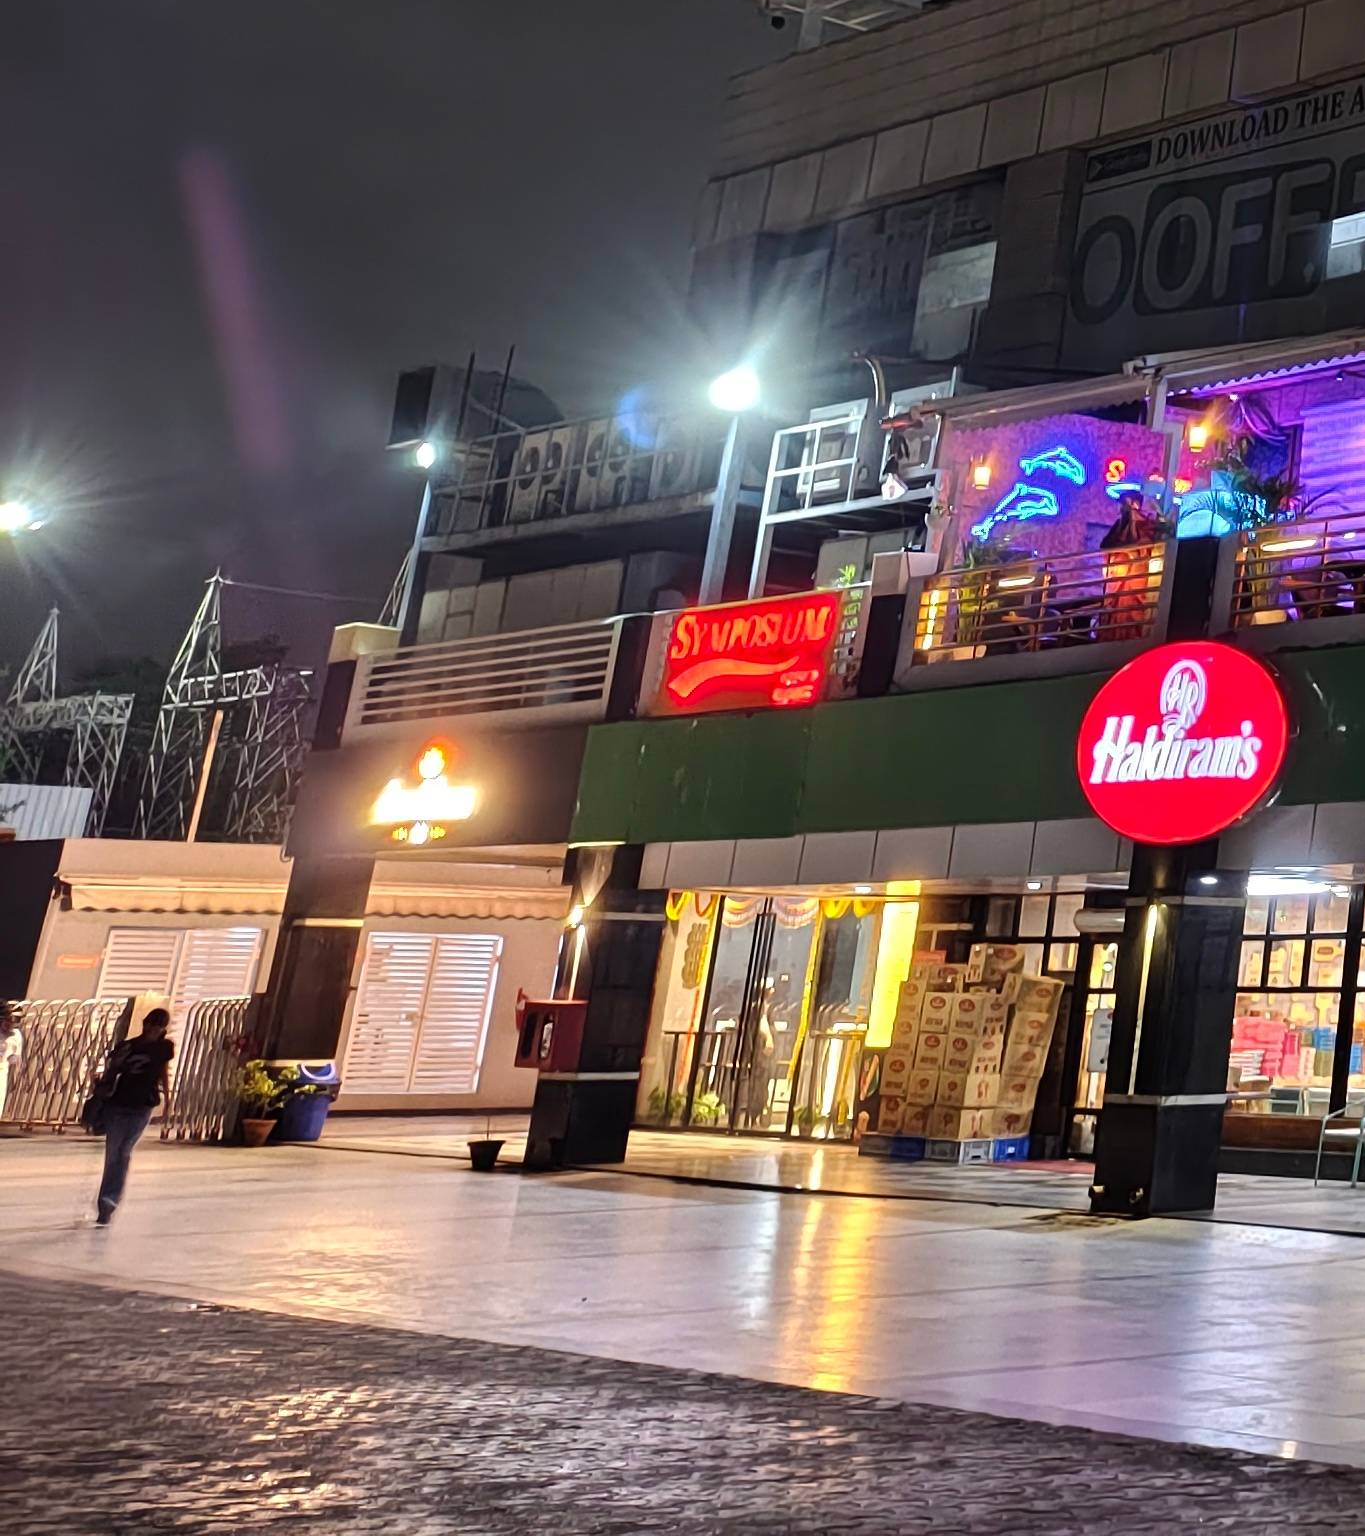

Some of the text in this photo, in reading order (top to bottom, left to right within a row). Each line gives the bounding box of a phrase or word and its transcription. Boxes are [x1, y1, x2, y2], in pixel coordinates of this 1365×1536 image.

[1155, 106, 1289, 166] DOWNLOAD
[1296, 91, 1344, 129] THE
[1089, 715, 1262, 784] Haldiram's
